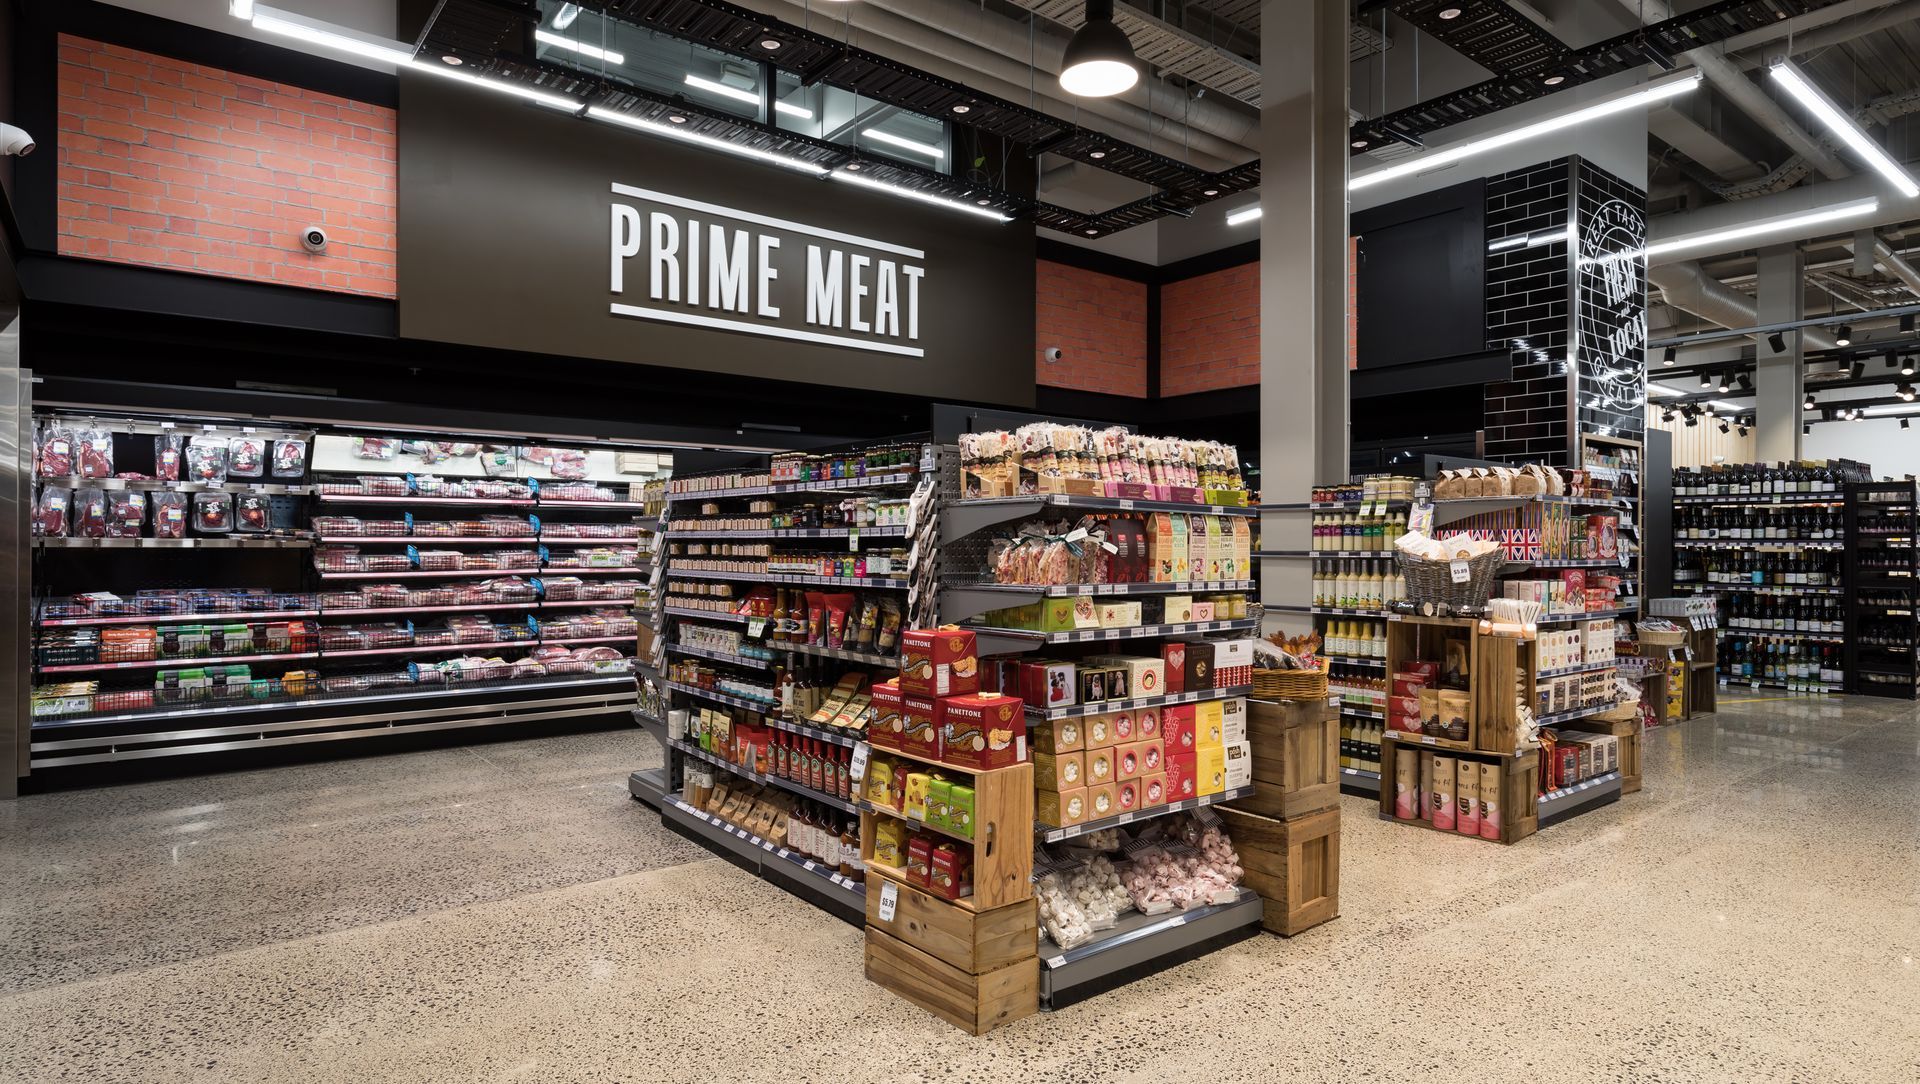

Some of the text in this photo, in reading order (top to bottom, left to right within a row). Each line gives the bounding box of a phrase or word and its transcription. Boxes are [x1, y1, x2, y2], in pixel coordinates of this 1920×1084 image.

[1583, 207, 1610, 272] GREAT
[611, 203, 925, 340] PRIME MEAT
[1602, 246, 1638, 308] FRESH
[903, 638, 931, 648] PANETTONE
[872, 692, 901, 703] PANETTONE
[905, 699, 933, 711] PANETTONE
[947, 707, 982, 718] PANETTONE
[881, 897, 895, 909] $5.79
